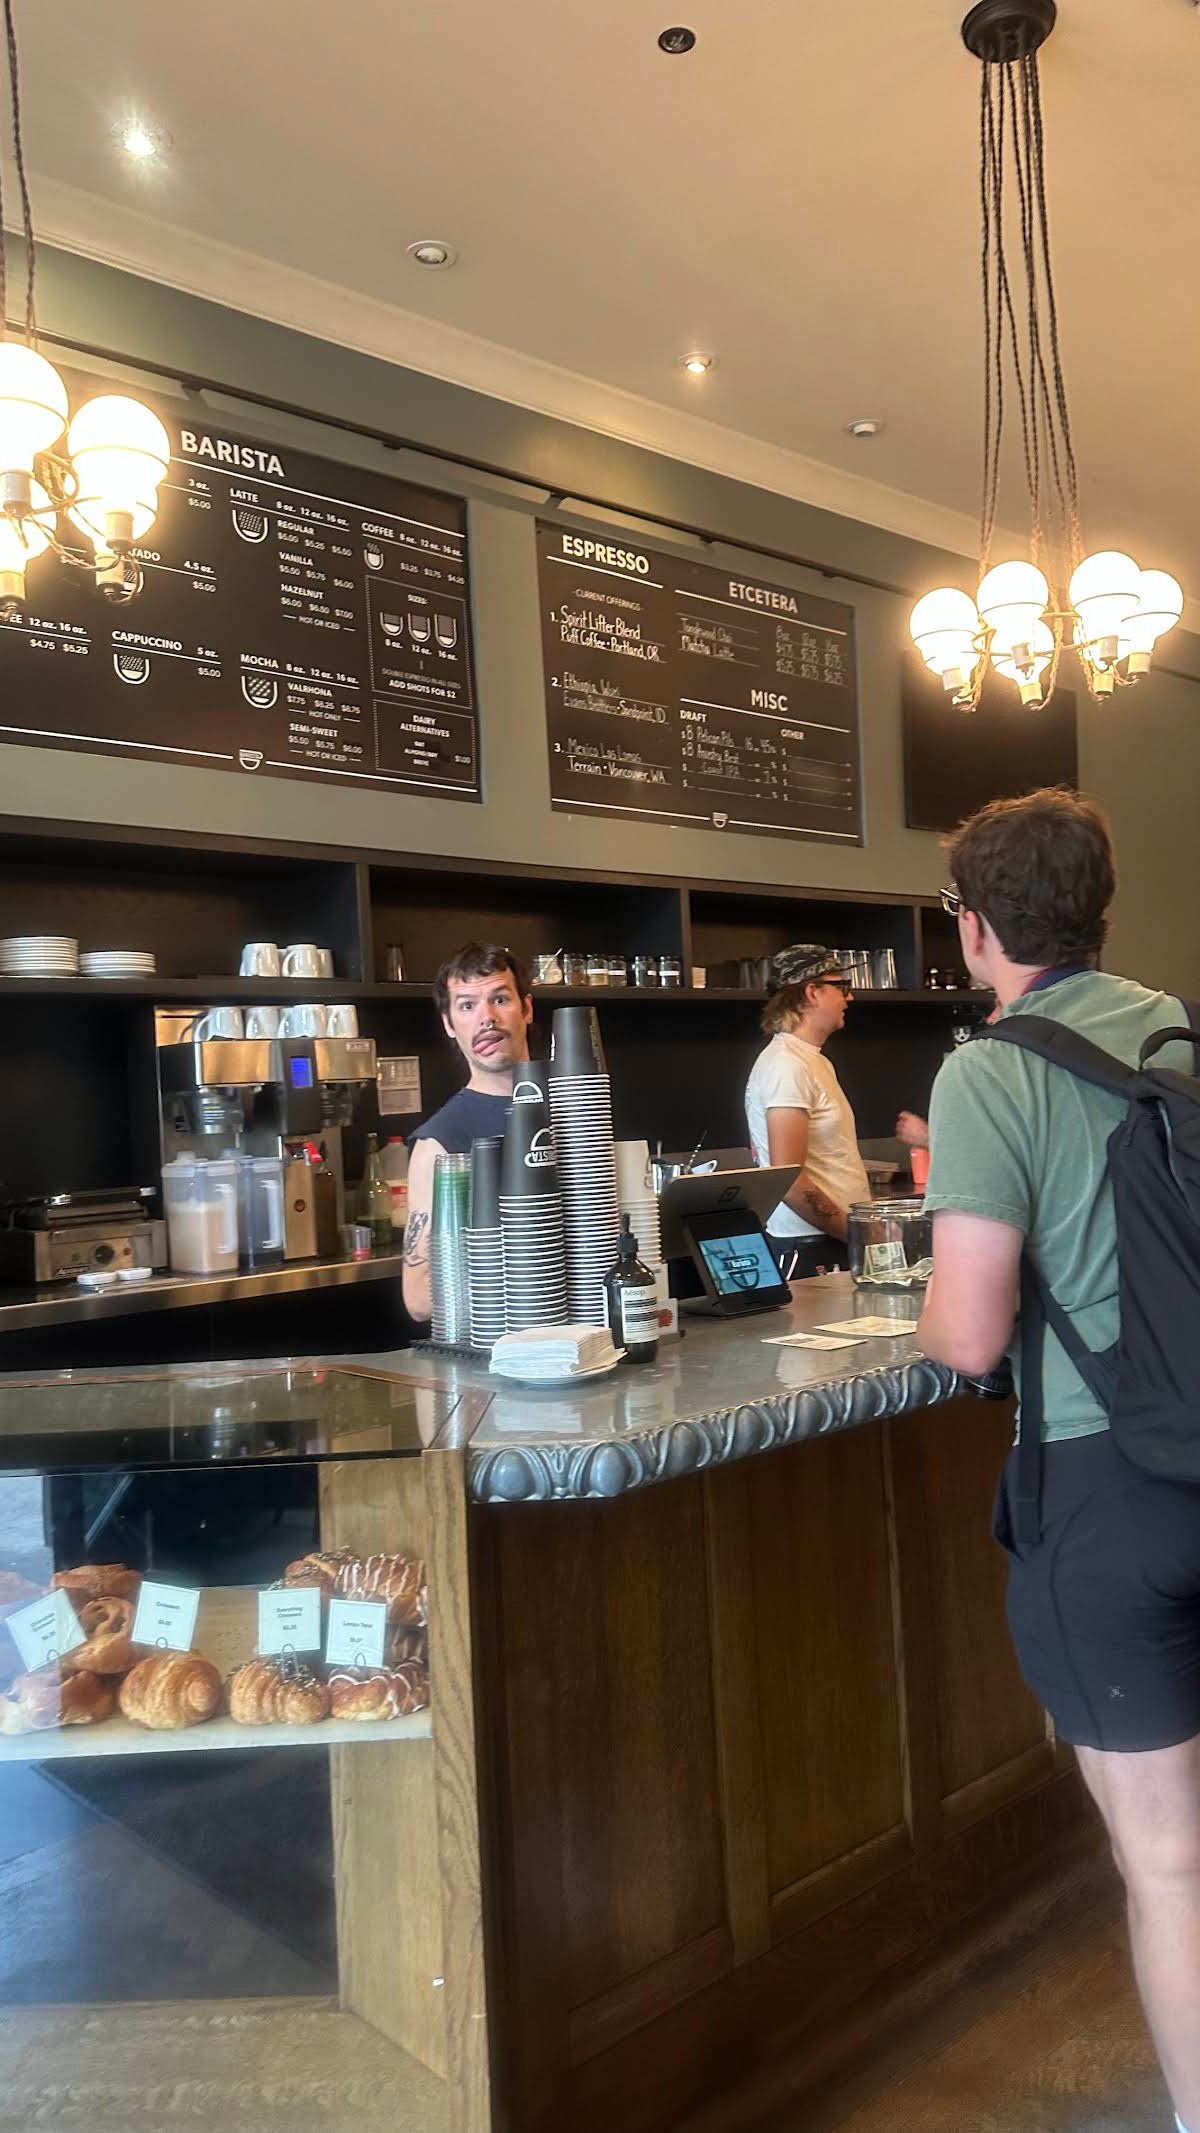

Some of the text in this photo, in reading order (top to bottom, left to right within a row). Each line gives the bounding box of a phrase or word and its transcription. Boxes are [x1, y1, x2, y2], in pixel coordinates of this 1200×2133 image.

[180, 430, 285, 477] BARISTA
[188, 479, 195, 487] 3
[188, 498, 211, 510] $5.00
[230, 488, 259, 502] LATTE
[300, 507, 310, 516] 12
[326, 513, 337, 523] 16
[277, 519, 315, 535] REGULAR
[361, 522, 395, 538] COFFEE
[421, 539, 429, 548] 12
[279, 552, 313, 566] VANILLA
[562, 534, 650, 574] ESPRESSO
[184, 560, 199, 571] 4.5
[193, 581, 216, 592] $5.00
[281, 583, 324, 599] HAZELNUT
[729, 581, 798, 613] ETCETERA
[29, 617, 41, 627] 12
[59, 623, 71, 632] 16
[560, 605, 587, 628] Spirit
[588, 612, 615, 633] Lifter
[615, 617, 641, 640] Blend
[112, 630, 182, 651] CAPPUCCINO
[197, 647, 203, 655] 5
[560, 624, 579, 643] Puff
[580, 629, 606, 649] Coffee
[30, 638, 88, 655] $4.75 $5.25
[412, 644, 420, 653] 12
[197, 667, 221, 678] $5.00
[240, 654, 279, 669] MOCHA
[311, 668, 320, 677] 12
[336, 673, 346, 682] 16
[287, 682, 333, 697] VALRHONA
[389, 680, 457, 699] ADD SHOTS FOR $2
[551, 677, 562, 687] 2.
[751, 689, 789, 712] MISC
[413, 715, 436, 726] DAIRY
[680, 709, 707, 723] DRAFT
[289, 723, 338, 737] SEMI-SWEET
[400, 723, 450, 738] ALTERNATIVES
[781, 729, 804, 740] OTHER
[554, 743, 564, 753] 3.
